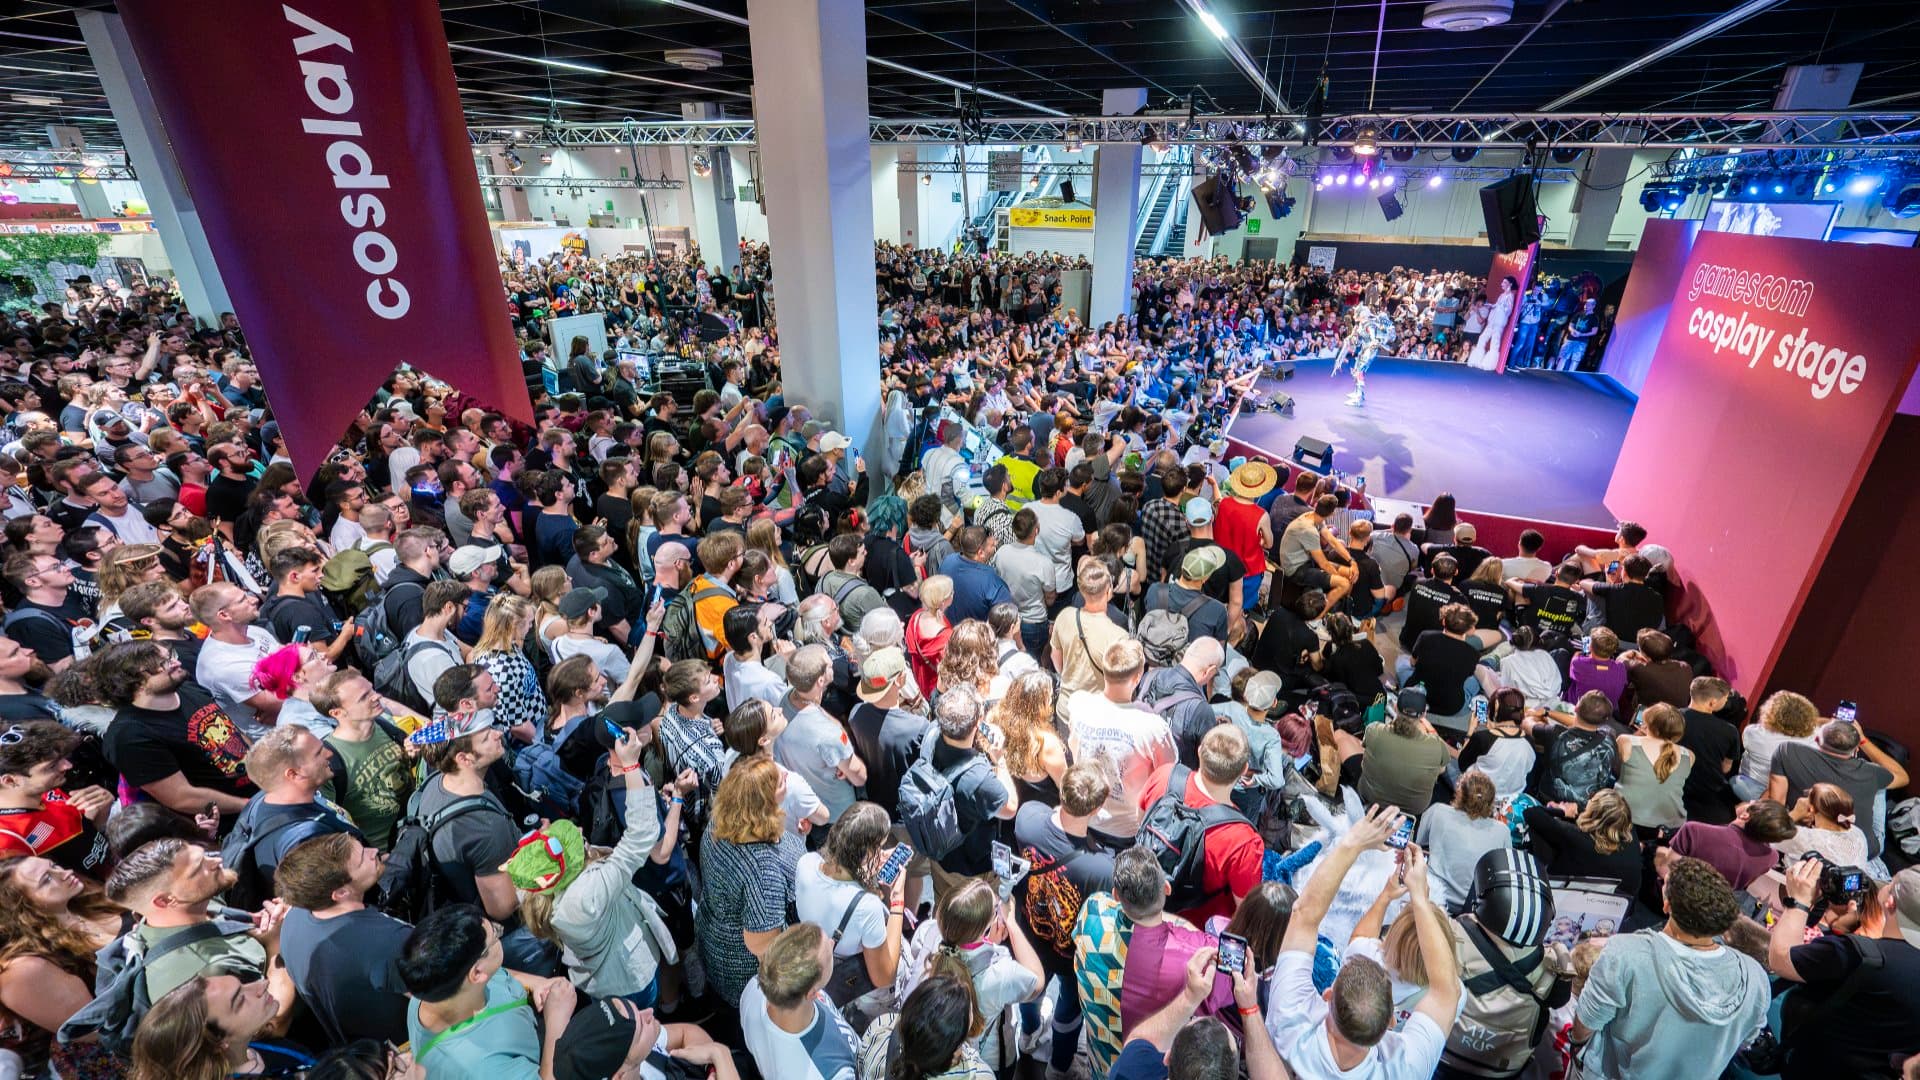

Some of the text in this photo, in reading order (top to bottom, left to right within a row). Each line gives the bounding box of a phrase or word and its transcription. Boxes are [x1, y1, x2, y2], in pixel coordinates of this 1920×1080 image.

[282, 3, 410, 320] cosplay
[1044, 213, 1091, 224] Snack Point
[1688, 261, 1815, 318] gamescom
[1689, 305, 1867, 399] cosplay stage
